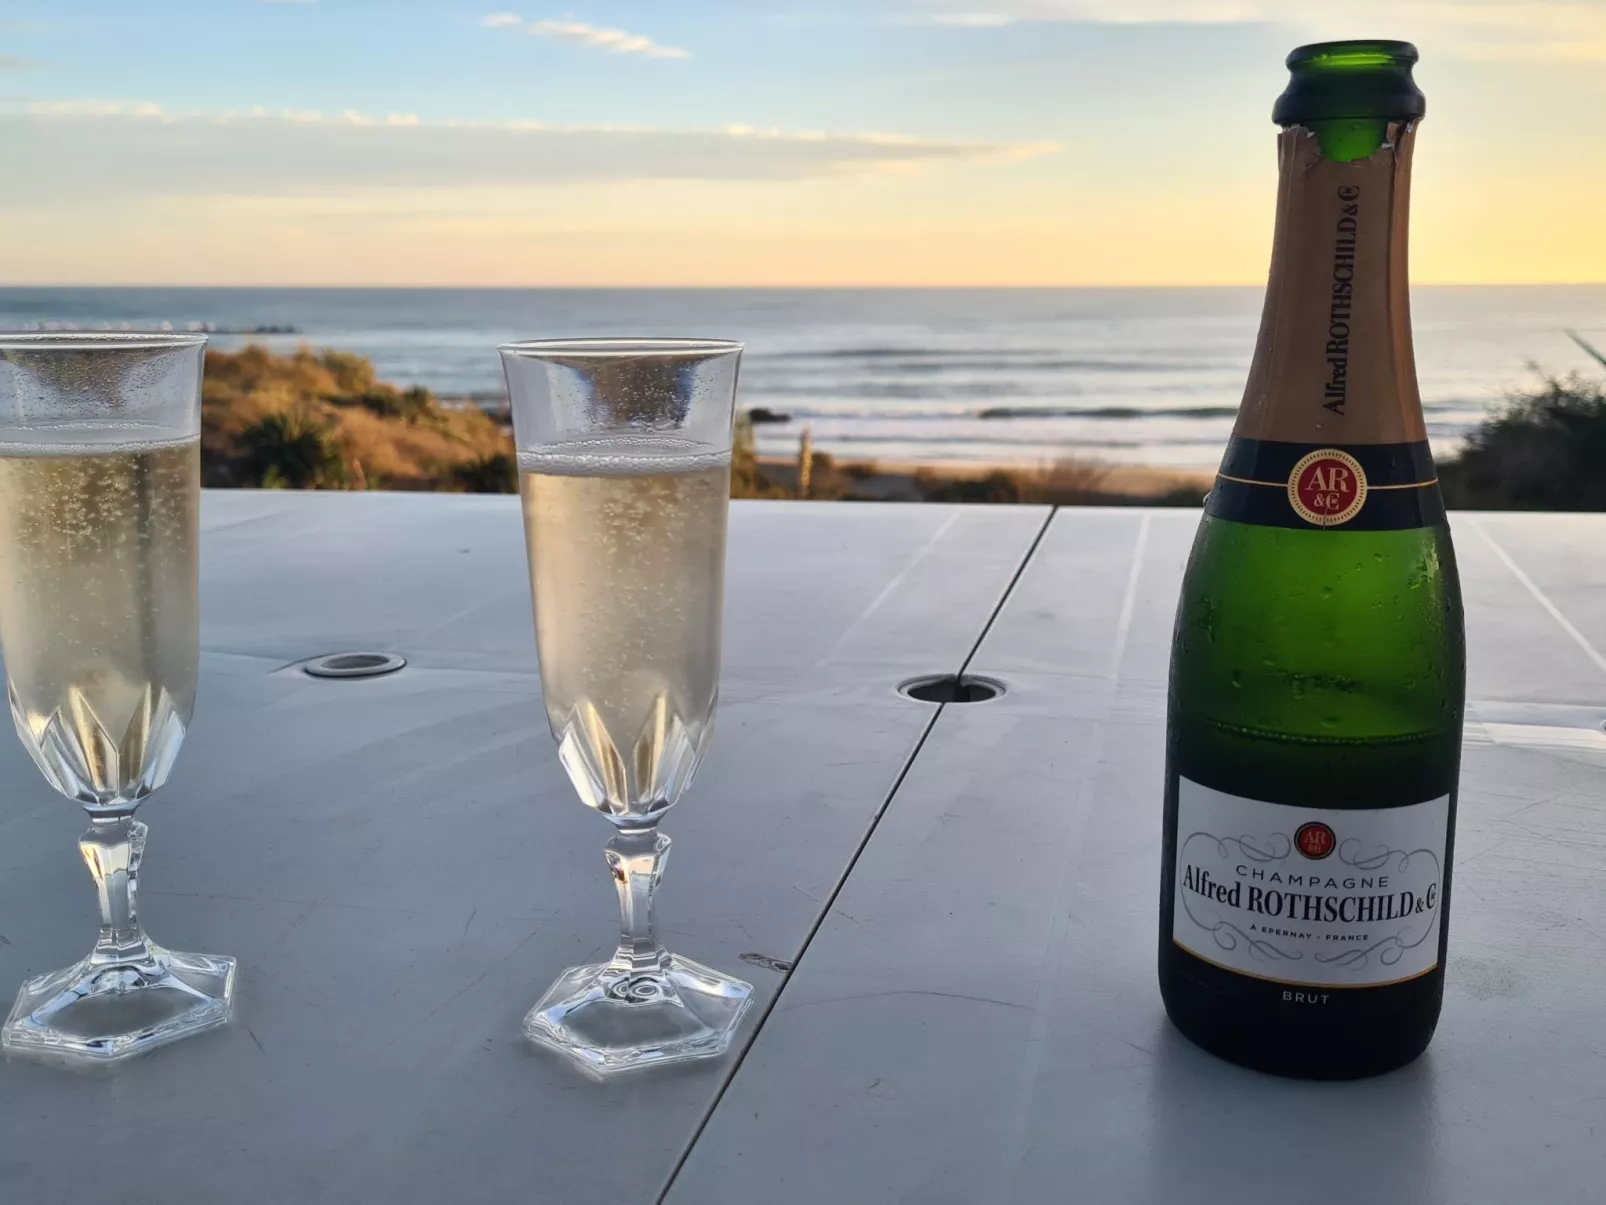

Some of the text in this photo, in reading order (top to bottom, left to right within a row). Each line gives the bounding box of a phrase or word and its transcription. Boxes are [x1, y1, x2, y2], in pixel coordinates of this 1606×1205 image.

[1325, 217, 1357, 355] ROTHSCHILD
[1322, 355, 1348, 416] Alfred
[1304, 466, 1350, 493] AR
[1303, 830, 1325, 844] AR
[1235, 864, 1389, 889] CHAMPAGNE
[1183, 863, 1241, 908] Alfred
[1247, 885, 1414, 923] ROTHSCHILD
[1261, 926, 1312, 939] EPERNAY
[1282, 990, 1330, 1005] BRUT
